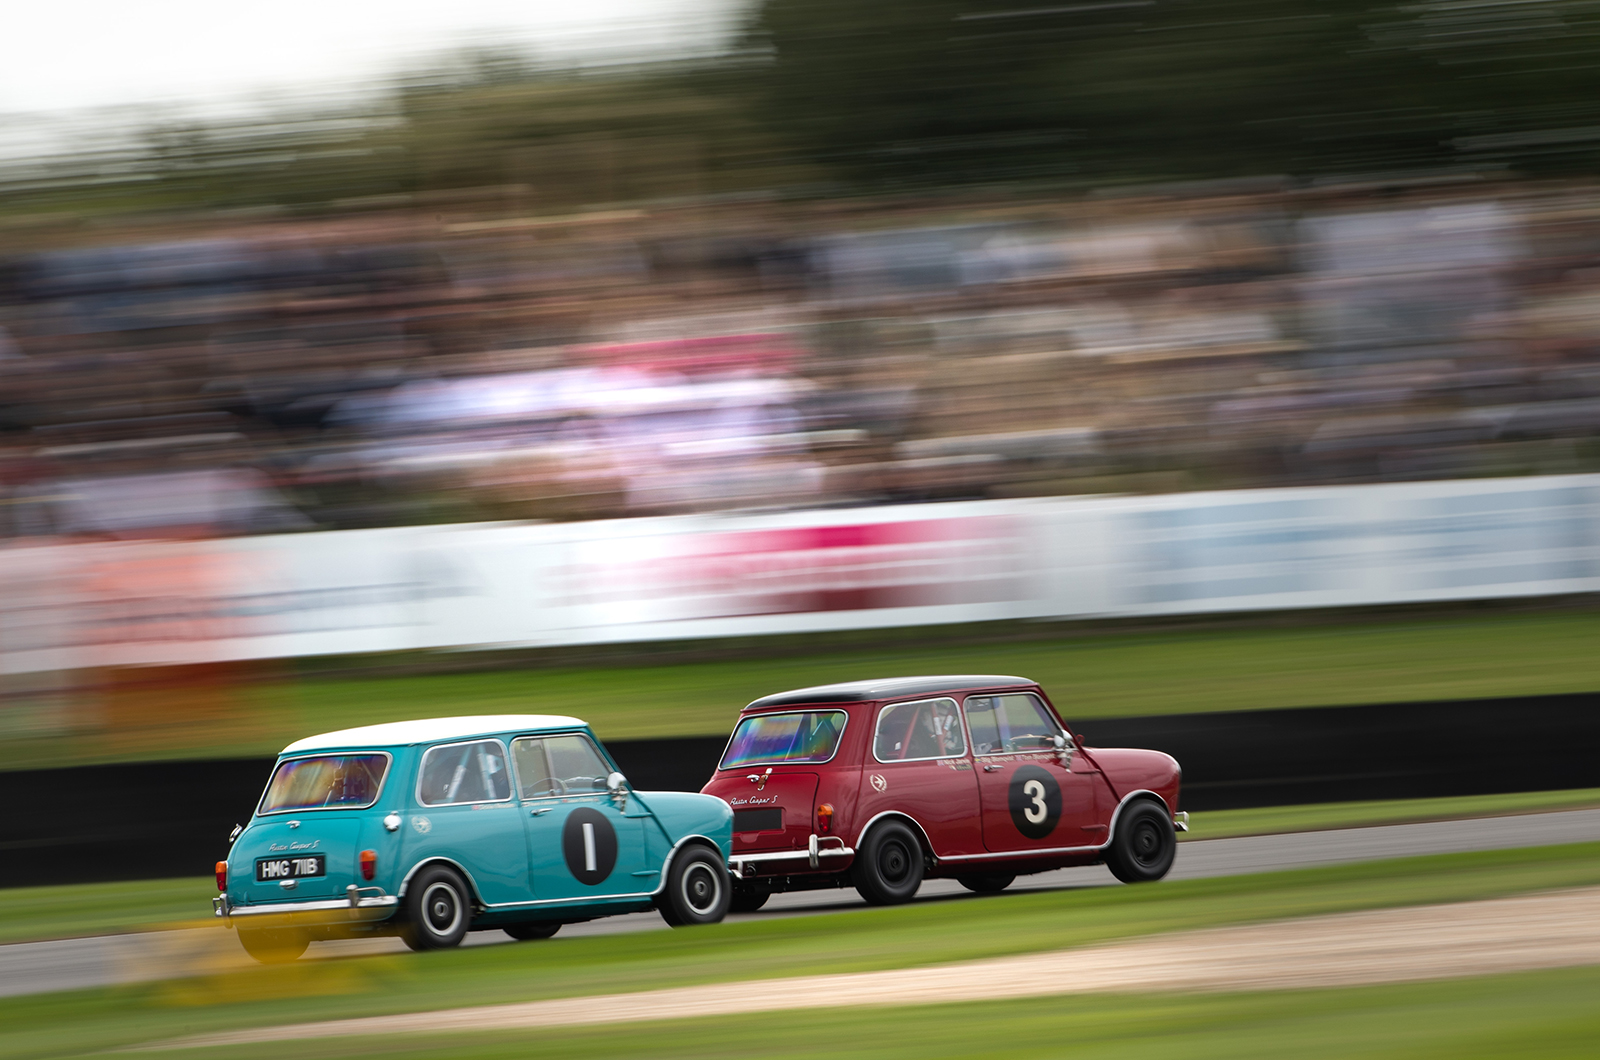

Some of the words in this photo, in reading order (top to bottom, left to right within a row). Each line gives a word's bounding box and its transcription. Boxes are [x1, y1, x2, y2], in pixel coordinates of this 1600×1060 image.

[730, 797, 748, 805] Austin
[749, 795, 770, 805] Cooper
[771, 795, 778, 803] S
[1023, 780, 1048, 824] 3
[311, 840, 321, 849] S
[582, 823, 597, 871] 1
[262, 860, 290, 878] HMG
[291, 858, 319, 876] 711B
